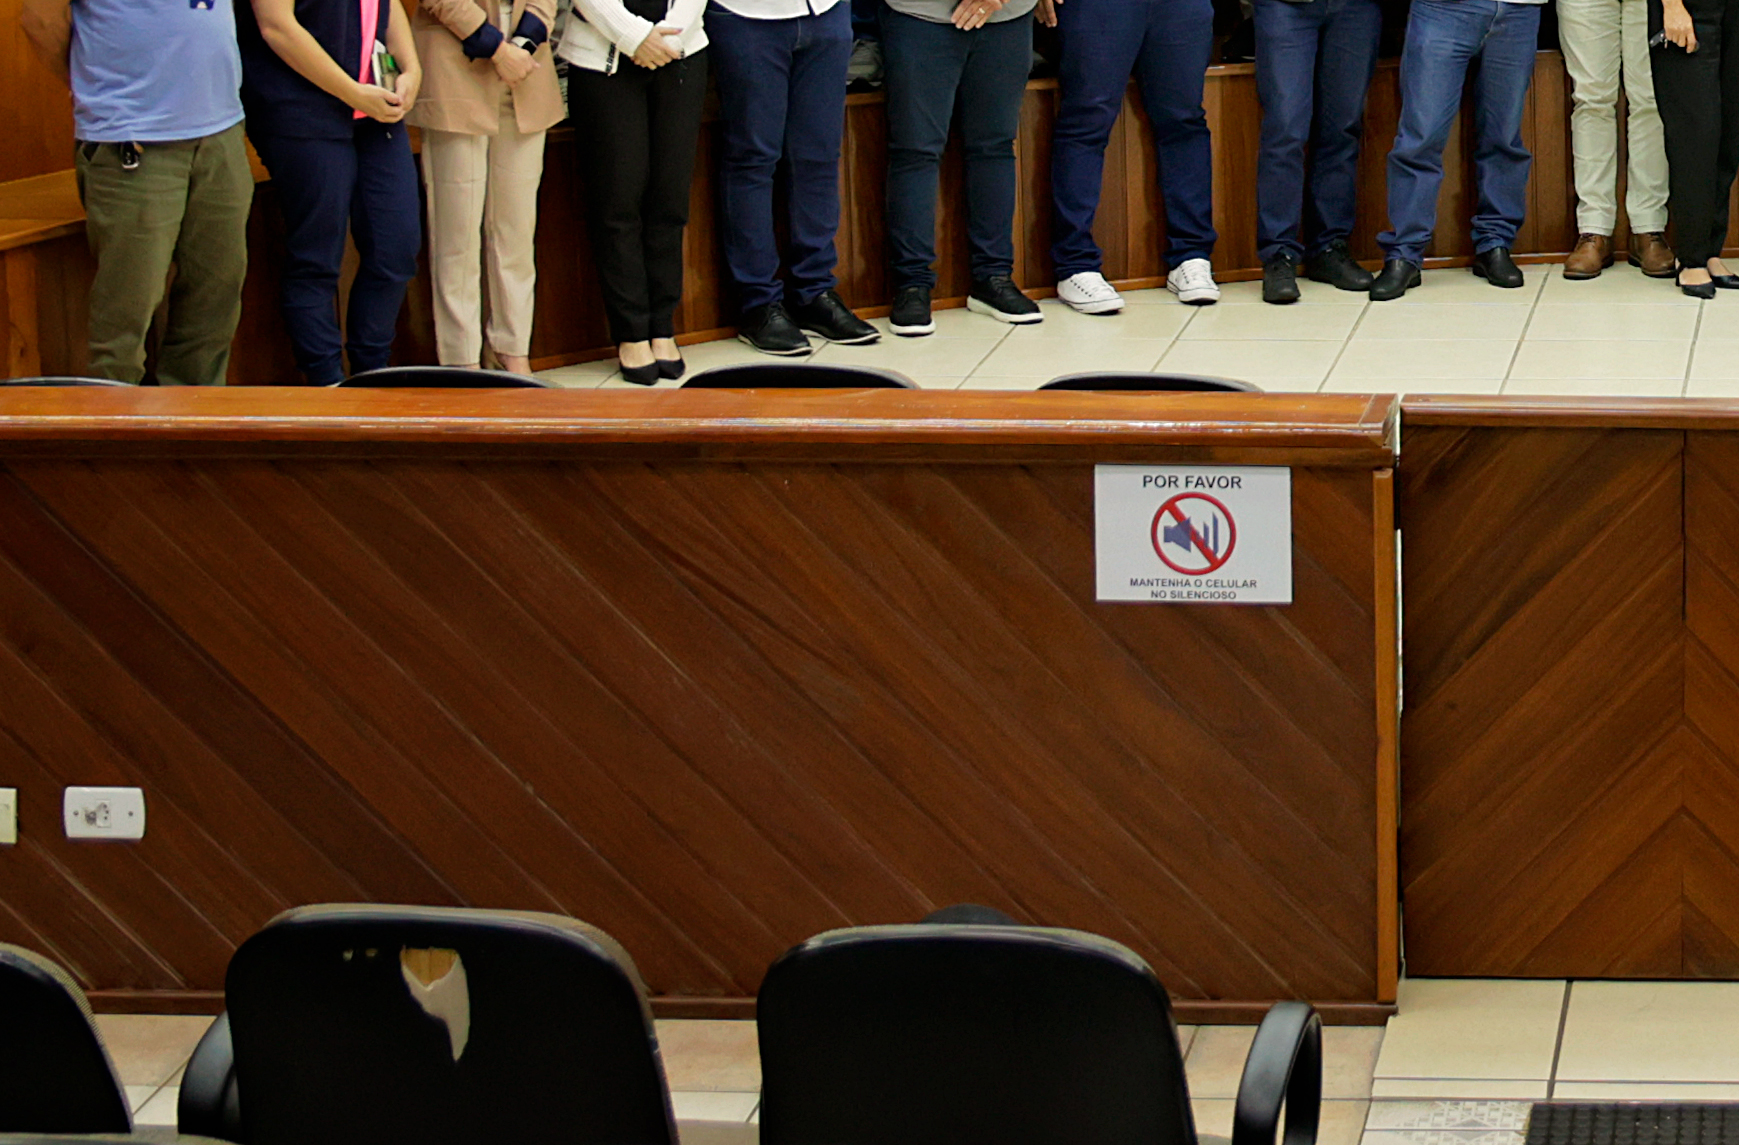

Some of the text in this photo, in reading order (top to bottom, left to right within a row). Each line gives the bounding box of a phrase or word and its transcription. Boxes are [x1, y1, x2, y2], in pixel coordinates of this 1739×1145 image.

[1142, 475, 1243, 489] POR FAVOR
[1129, 578, 1258, 589] MANTENHA O CELULAR
[1150, 590, 1237, 600] NO SILENCIOSO
